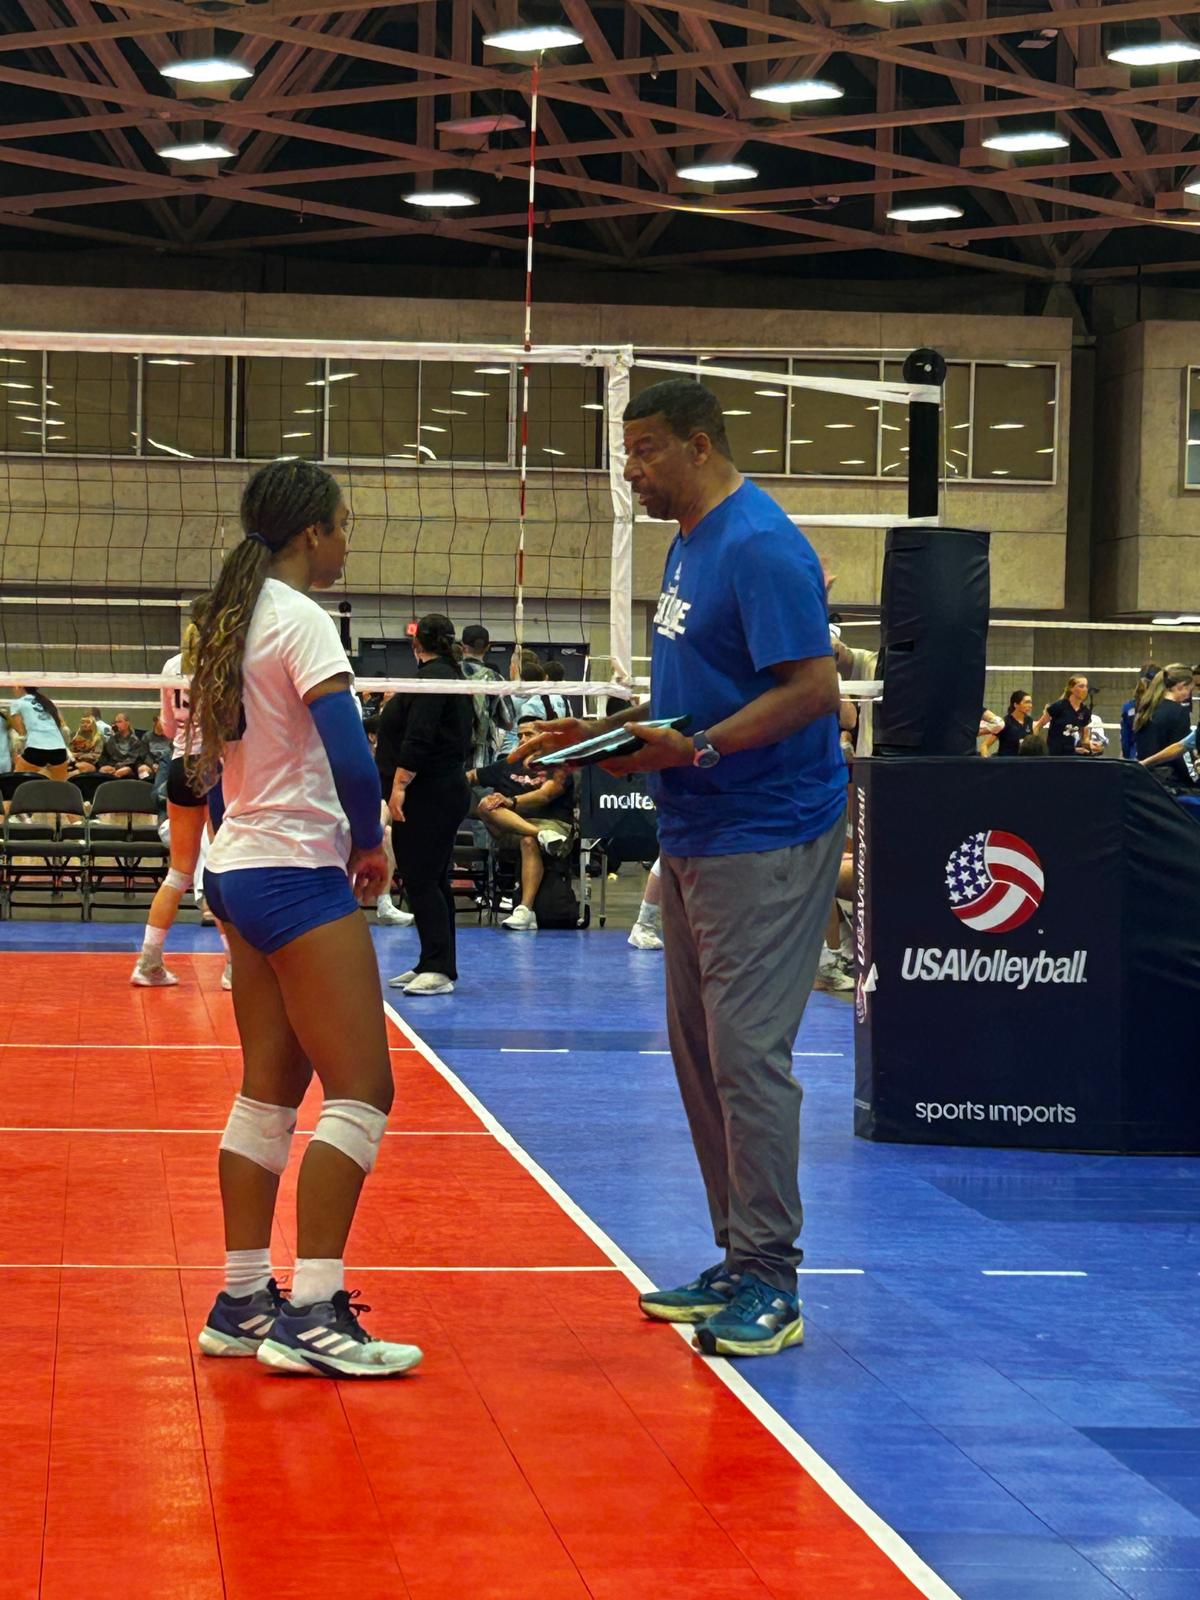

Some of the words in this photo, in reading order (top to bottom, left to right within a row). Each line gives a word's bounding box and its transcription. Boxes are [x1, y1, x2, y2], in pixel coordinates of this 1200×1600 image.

[599, 792, 657, 810] molte
[915, 1100, 985, 1123] sports
[989, 1103, 1076, 1126] imports
